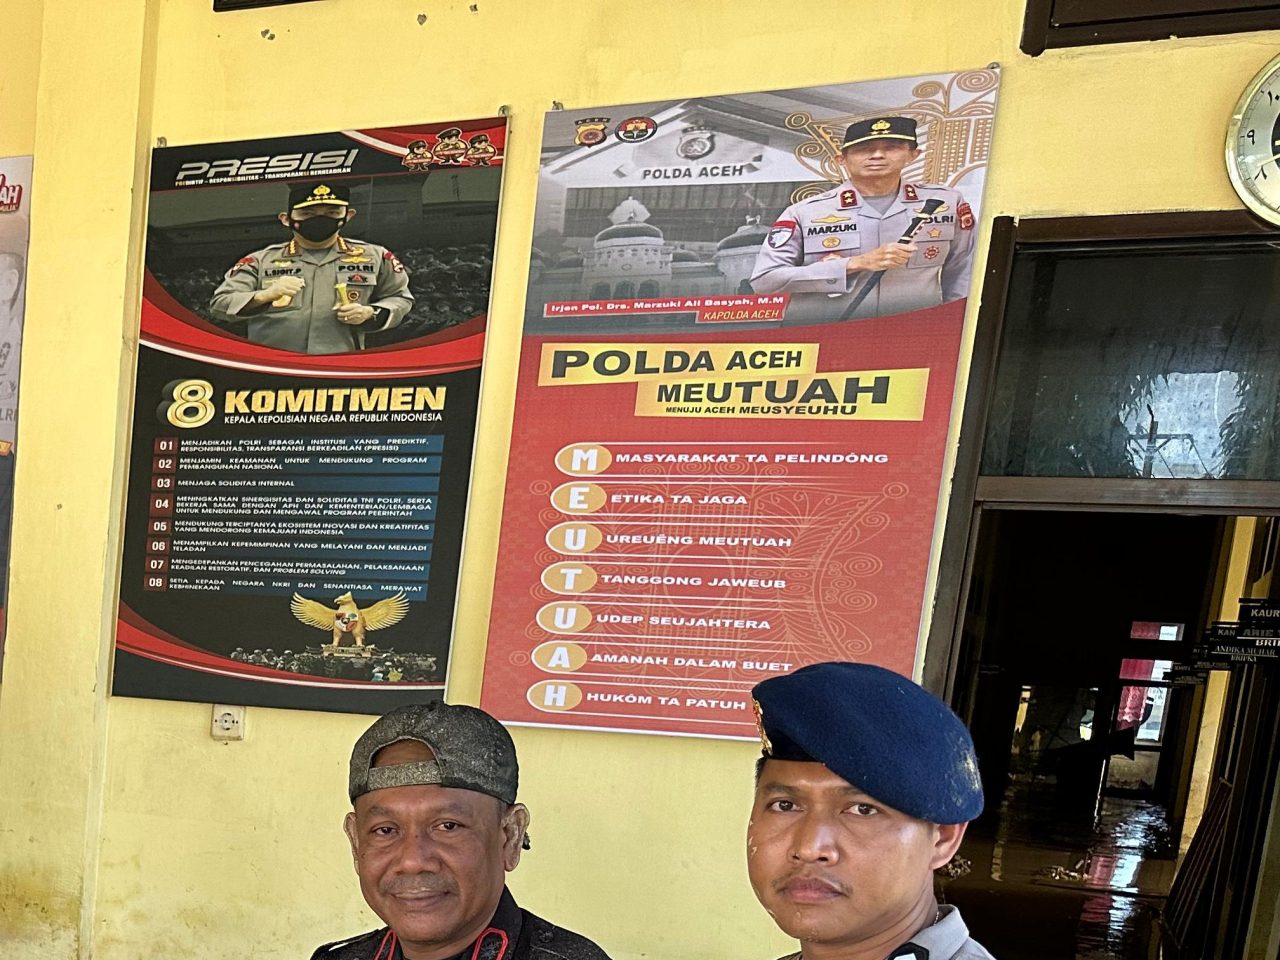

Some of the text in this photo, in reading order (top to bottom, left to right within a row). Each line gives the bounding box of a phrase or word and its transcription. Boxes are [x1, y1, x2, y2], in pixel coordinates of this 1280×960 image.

[176, 148, 359, 181] PRESISI
[643, 165, 744, 180] POLDA ACEH
[926, 215, 954, 224] OLRI
[807, 223, 857, 236] MARZUKI
[551, 304, 578, 313] Irjen
[634, 300, 681, 309] Marzuki
[684, 299, 701, 307] Ali
[704, 310, 779, 320] KAPOLDA ACEH
[551, 350, 802, 379] POLDA ACEH
[656, 376, 890, 403] MEUTUAH
[167, 379, 447, 428] 8 KOMITMEN
[665, 405, 857, 415] MENUJU ACEH MEUSYEUHU
[224, 412, 442, 424] KEPALA KEPOLISIAN NEGARA REPUBLIK INDONESIA
[160, 441, 173, 450] 01
[158, 459, 172, 469] 02
[571, 449, 598, 471] M
[615, 454, 740, 463] MASYARAKAT
[745, 454, 768, 463] TA
[157, 479, 171, 488] 03
[569, 487, 590, 509] E
[611, 494, 747, 504] ETIKA TA JAGA
[564, 528, 587, 550] U
[699, 536, 792, 547] MEUTUAH
[560, 568, 583, 590] T
[601, 575, 786, 589] TANGGONG JAWEUB
[553, 607, 577, 629] U
[596, 615, 771, 630] UDEP SEUJAHTERA
[547, 646, 570, 668] A
[591, 654, 793, 672] AMANAH DALAM BUET
[544, 685, 567, 706] H
[658, 696, 680, 706] TA
[686, 698, 746, 710] PATUH
